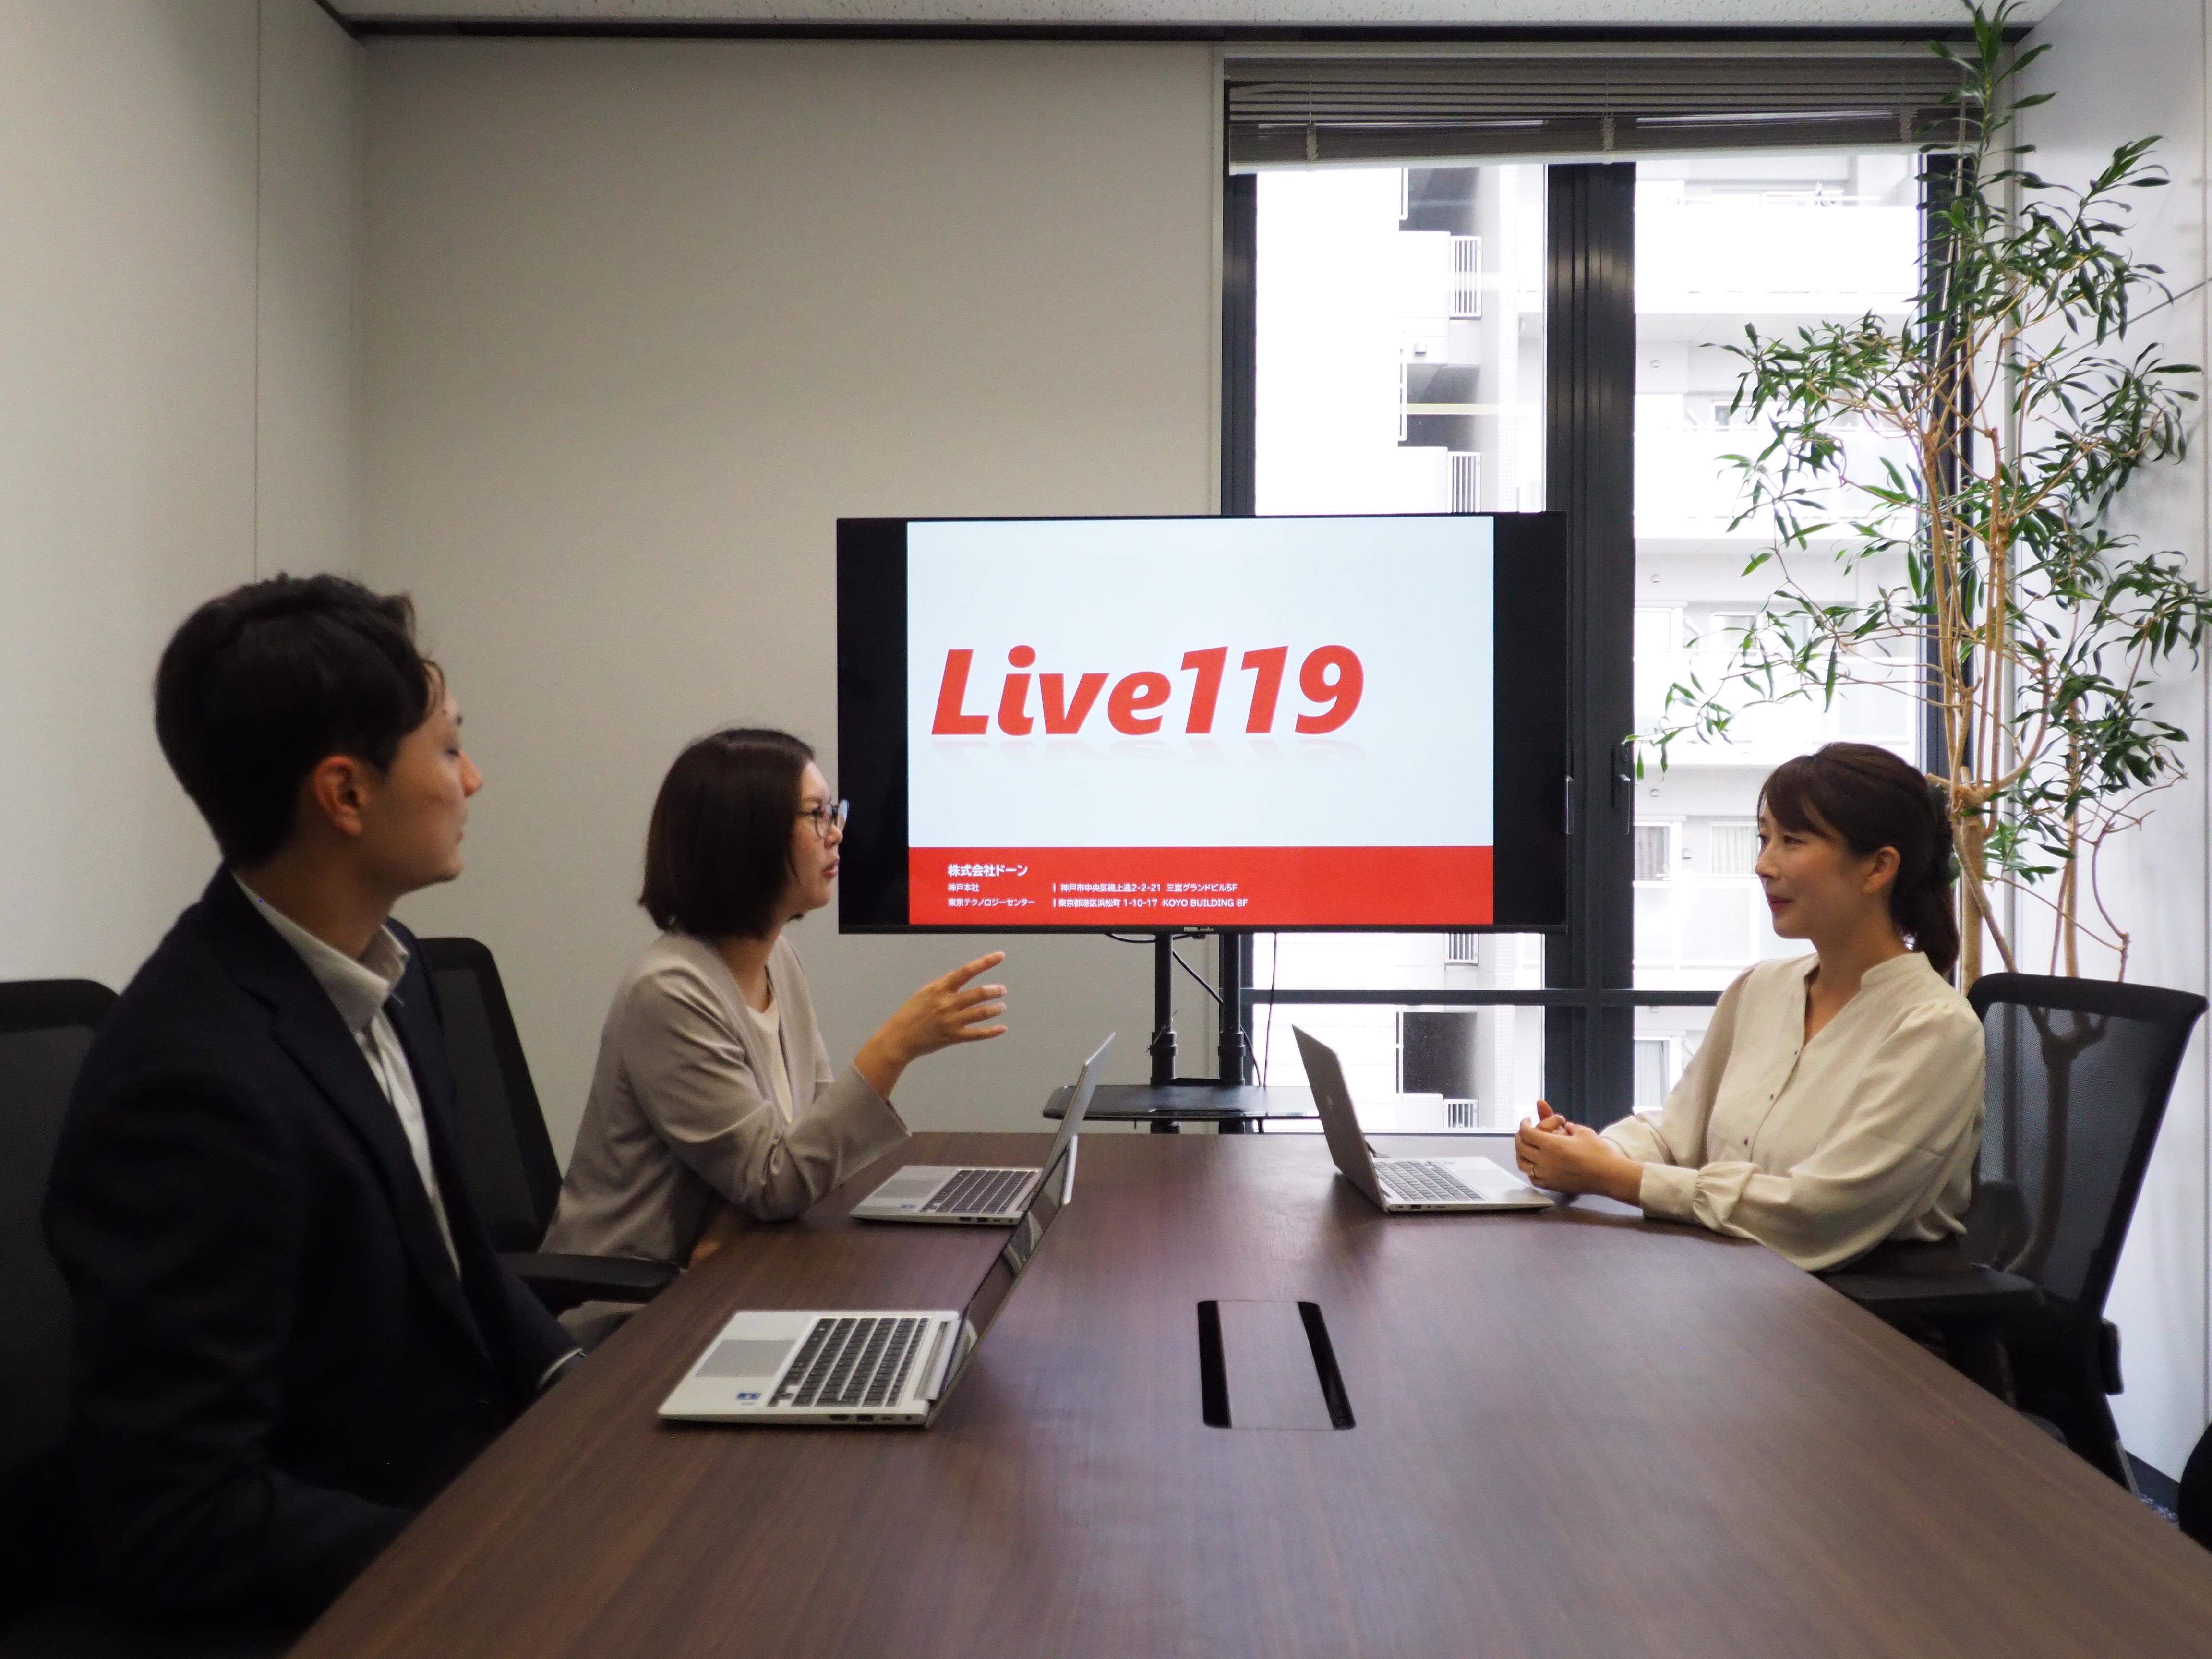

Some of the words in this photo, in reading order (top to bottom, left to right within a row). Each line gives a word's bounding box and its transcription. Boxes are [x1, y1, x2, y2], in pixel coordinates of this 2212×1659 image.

[931, 644, 1365, 736] Live119
[948, 864, 1028, 877] 株式会社ドーン
[948, 883, 980, 892] 神戸本社
[948, 898, 1035, 907] 東京テクノロジーセンター
[1058, 898, 1121, 908] 東京都港区浜松町
[1124, 899, 1158, 907] 1-10-17
[1163, 899, 1188, 907] KOYO
[1190, 899, 1234, 907] BUILDING
[1237, 899, 1248, 907] 8F
